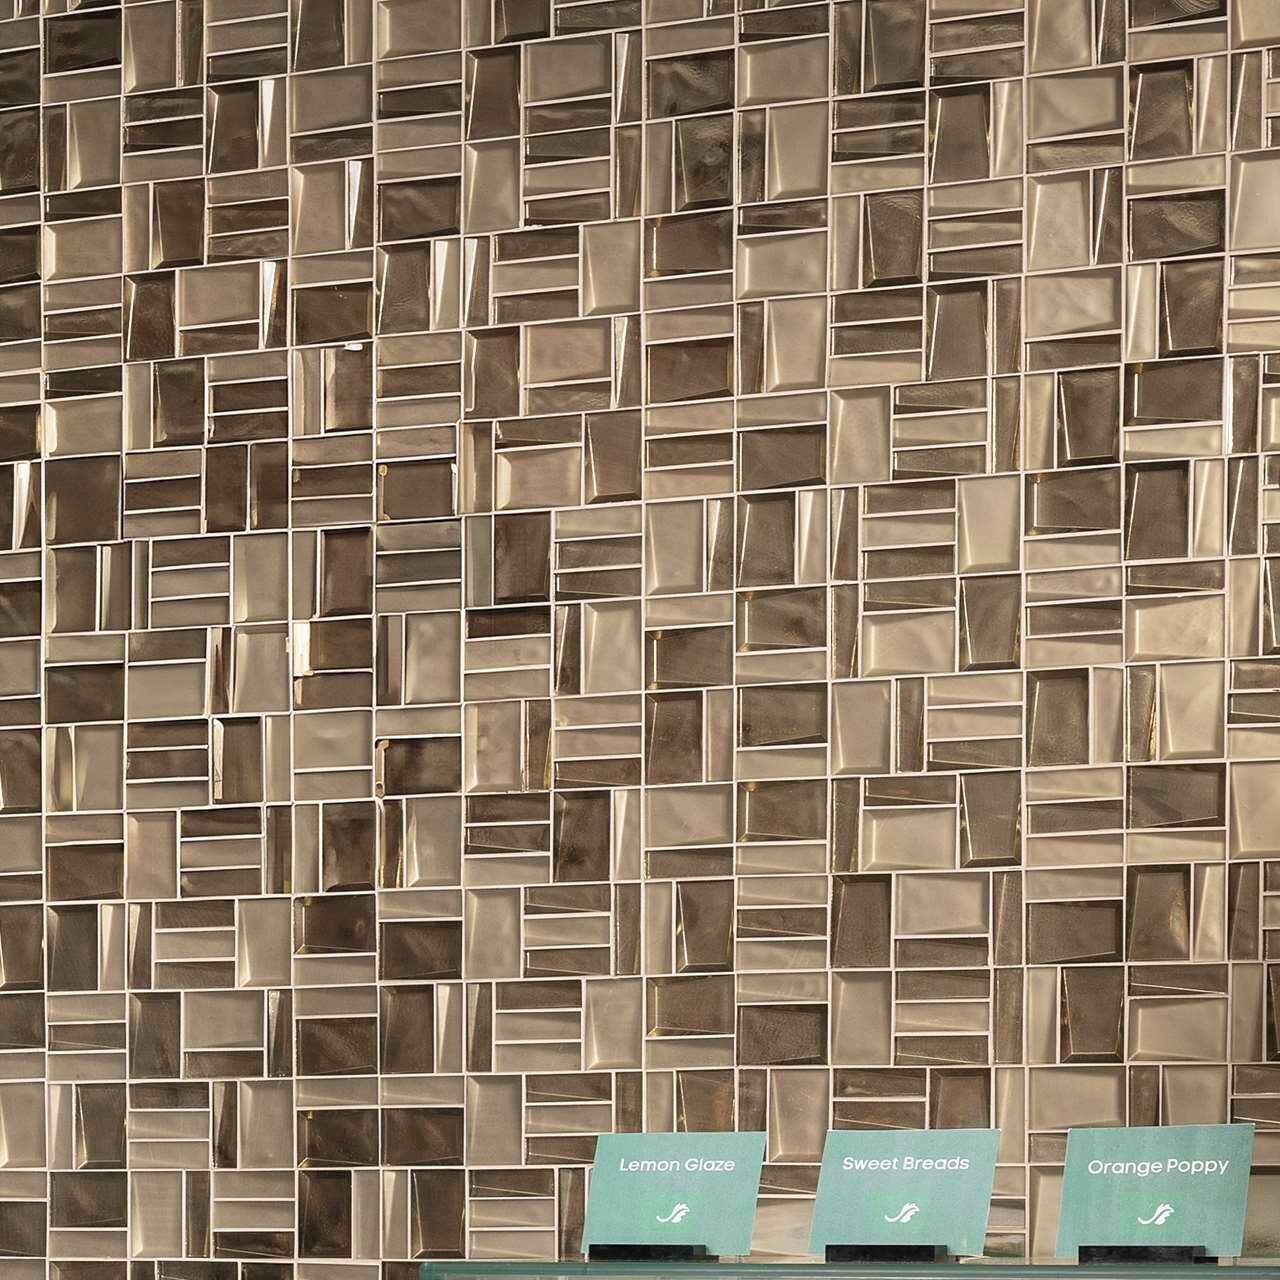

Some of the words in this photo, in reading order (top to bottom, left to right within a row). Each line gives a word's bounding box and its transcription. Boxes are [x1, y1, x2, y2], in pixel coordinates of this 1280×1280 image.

[619, 1158, 680, 1172] Lemon
[685, 1157, 736, 1172] Glaze
[842, 1156, 898, 1170] Sweet
[903, 1156, 970, 1170] Breads
[1088, 1160, 1163, 1177] Orange
[1167, 1158, 1230, 1175] Poppy
